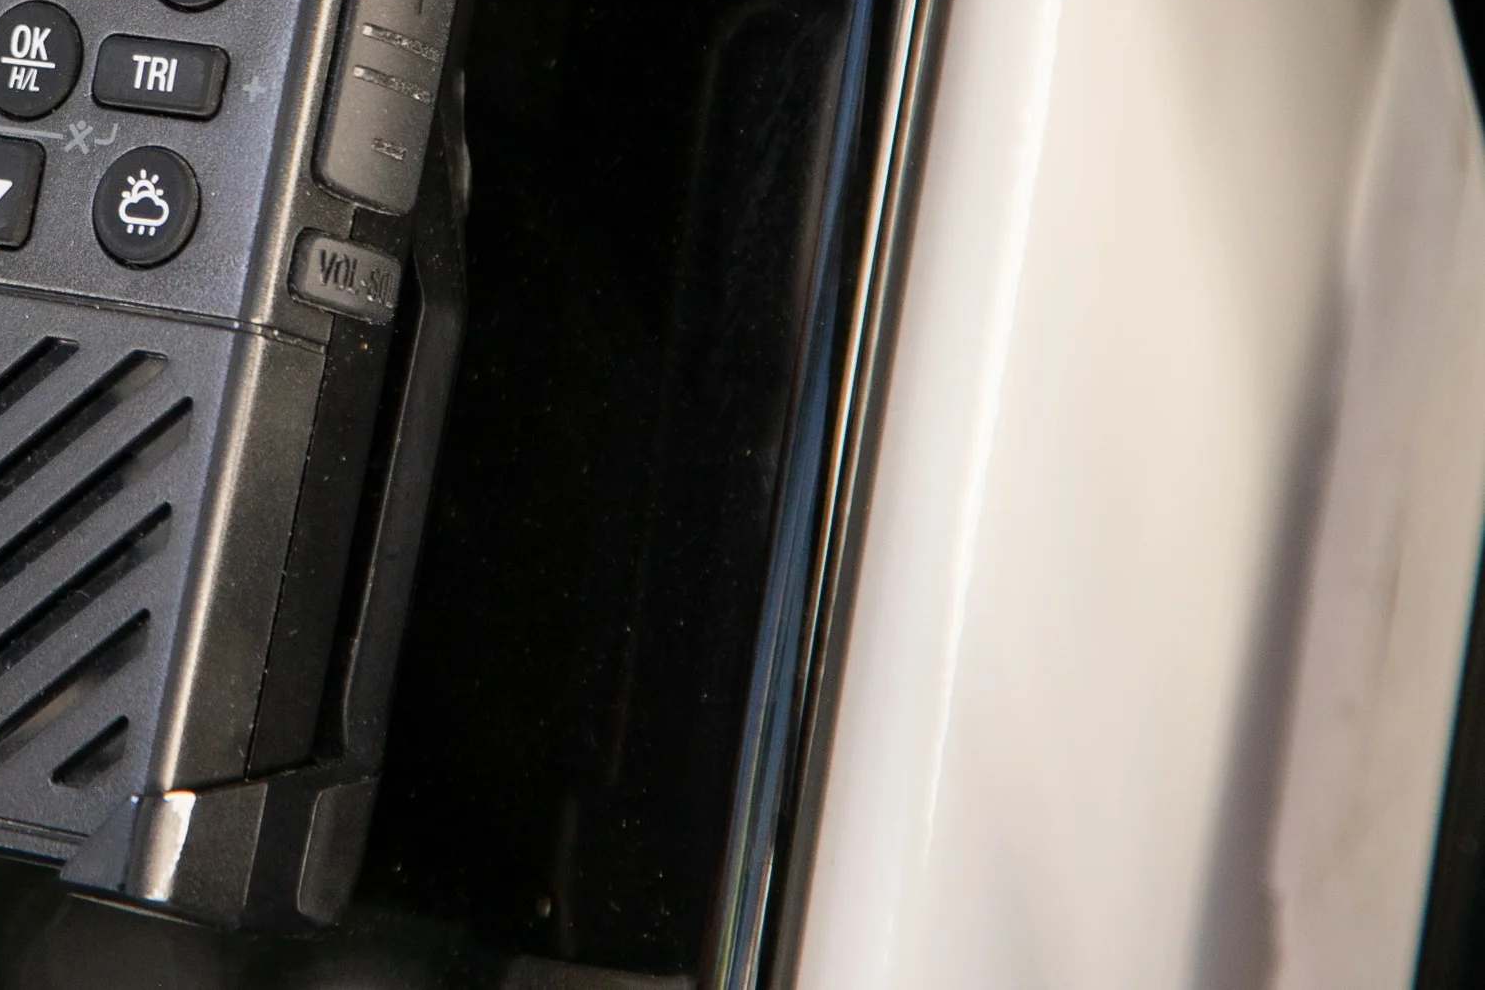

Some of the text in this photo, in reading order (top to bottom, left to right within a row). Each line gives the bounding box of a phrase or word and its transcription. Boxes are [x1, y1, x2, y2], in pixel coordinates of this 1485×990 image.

[10, 24, 52, 60] OK
[8, 66, 40, 92] H/L
[132, 54, 178, 92] TRI
